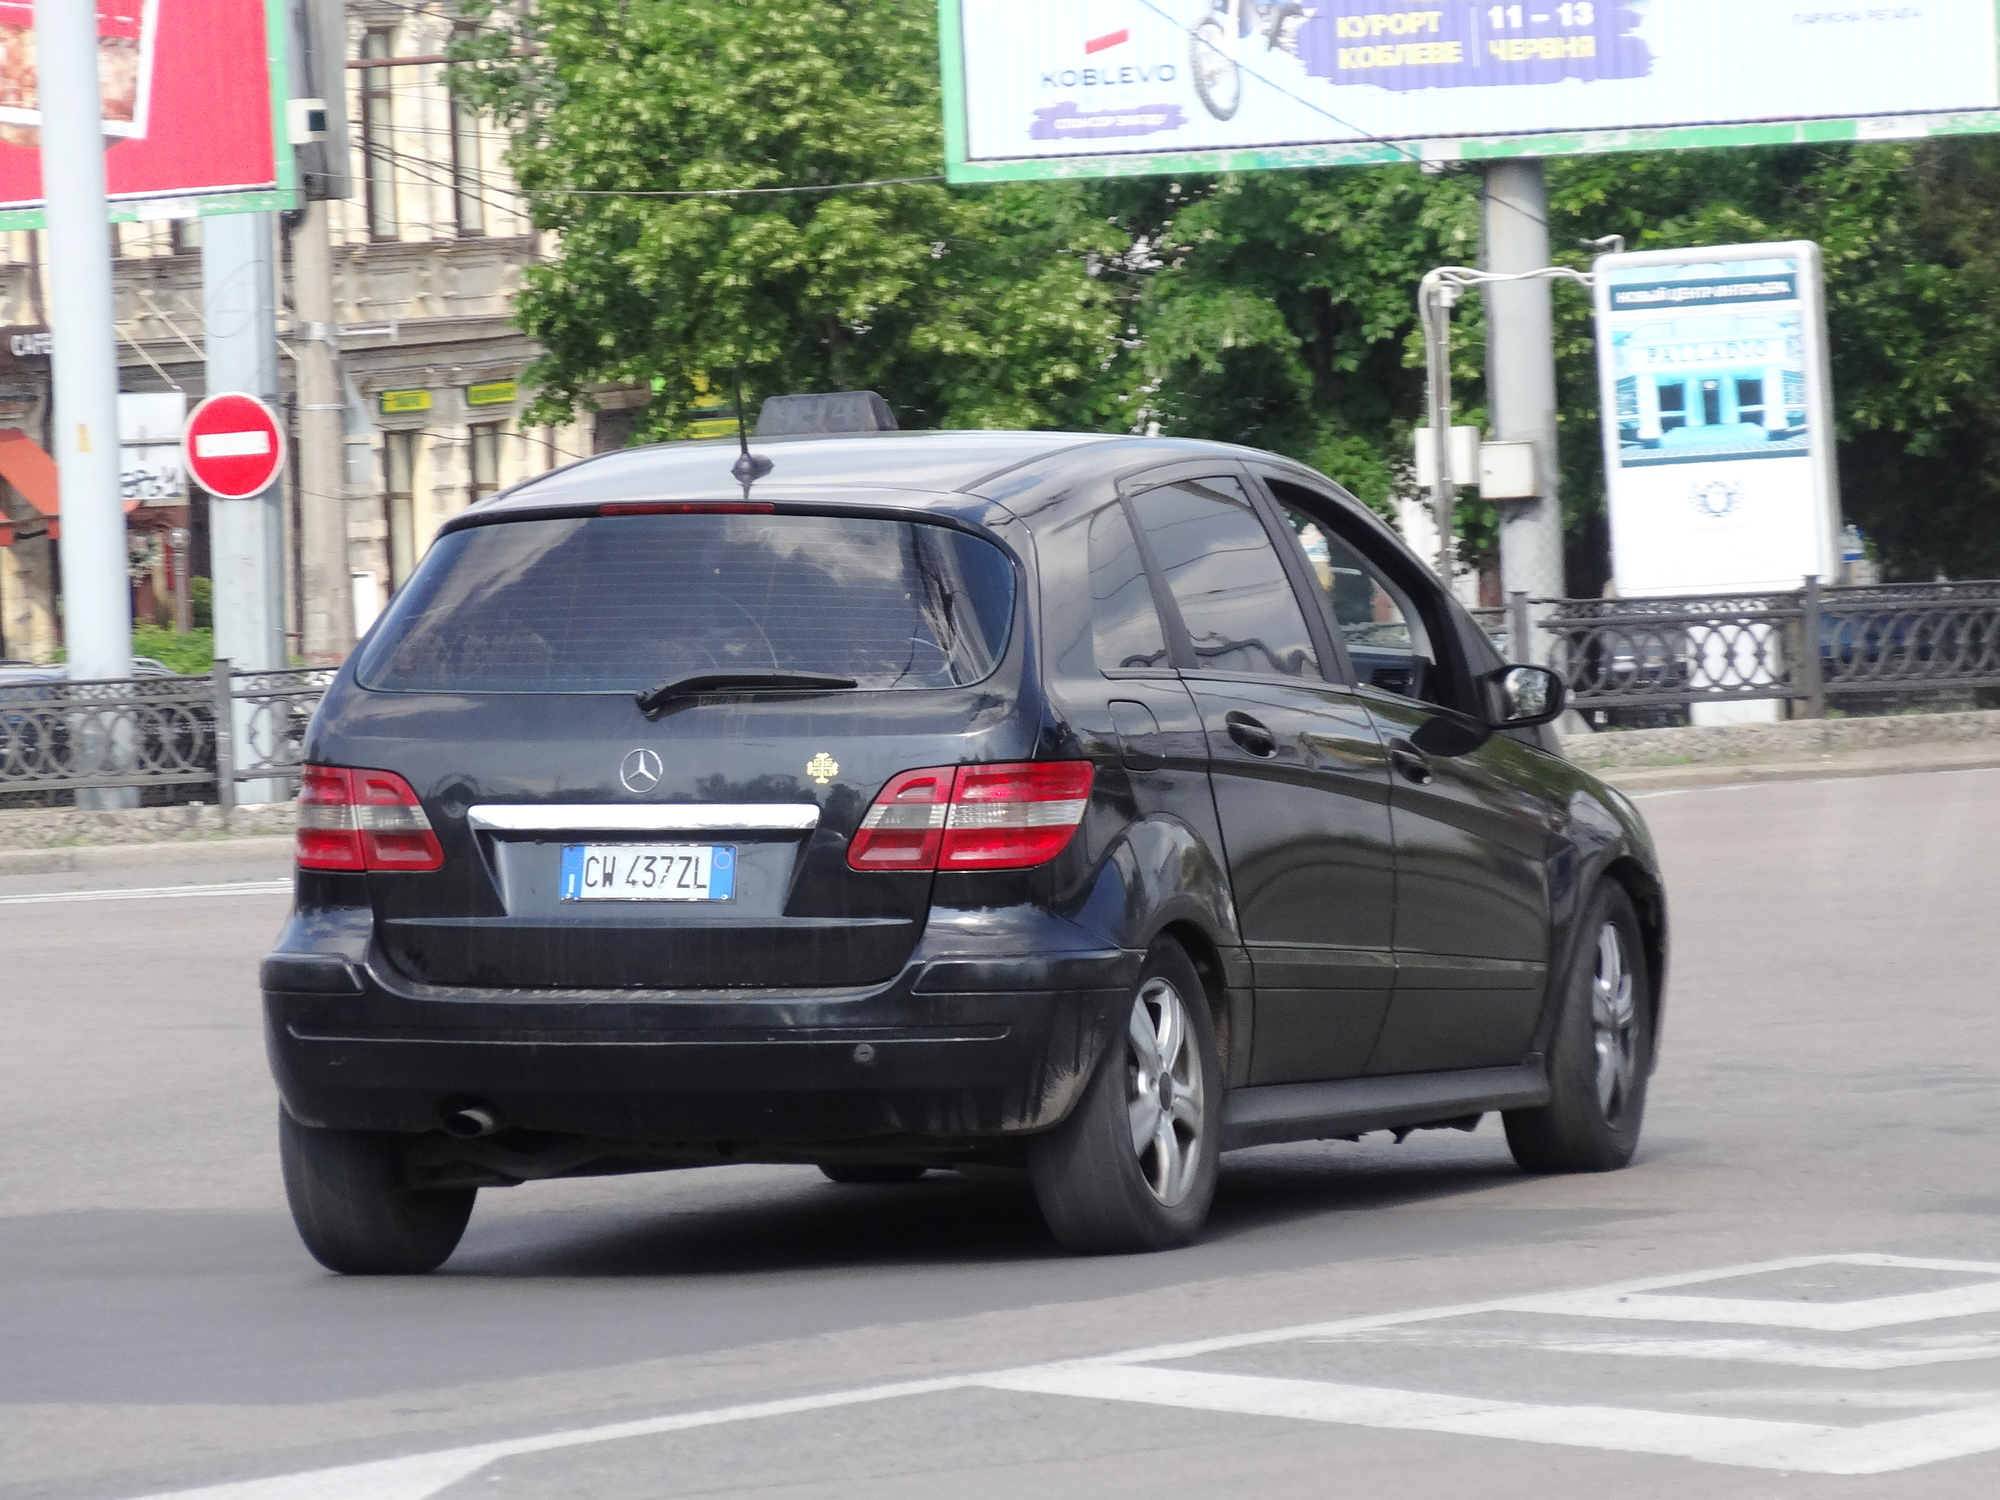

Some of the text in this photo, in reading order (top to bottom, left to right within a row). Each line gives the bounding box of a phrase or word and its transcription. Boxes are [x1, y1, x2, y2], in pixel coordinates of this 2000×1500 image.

[1336, 11, 1442, 38] КУРОРТ
[1488, 5, 1523, 28] 11
[1556, 2, 1595, 26] 13
[1338, 41, 1463, 69] КОБЛЕВЕ
[1488, 36, 1596, 61] ЧЕРВНЯ
[1040, 64, 1177, 88] KOBLEVO
[1648, 340, 1768, 364] PALLADIO
[585, 856, 707, 889] CW 437ZL
